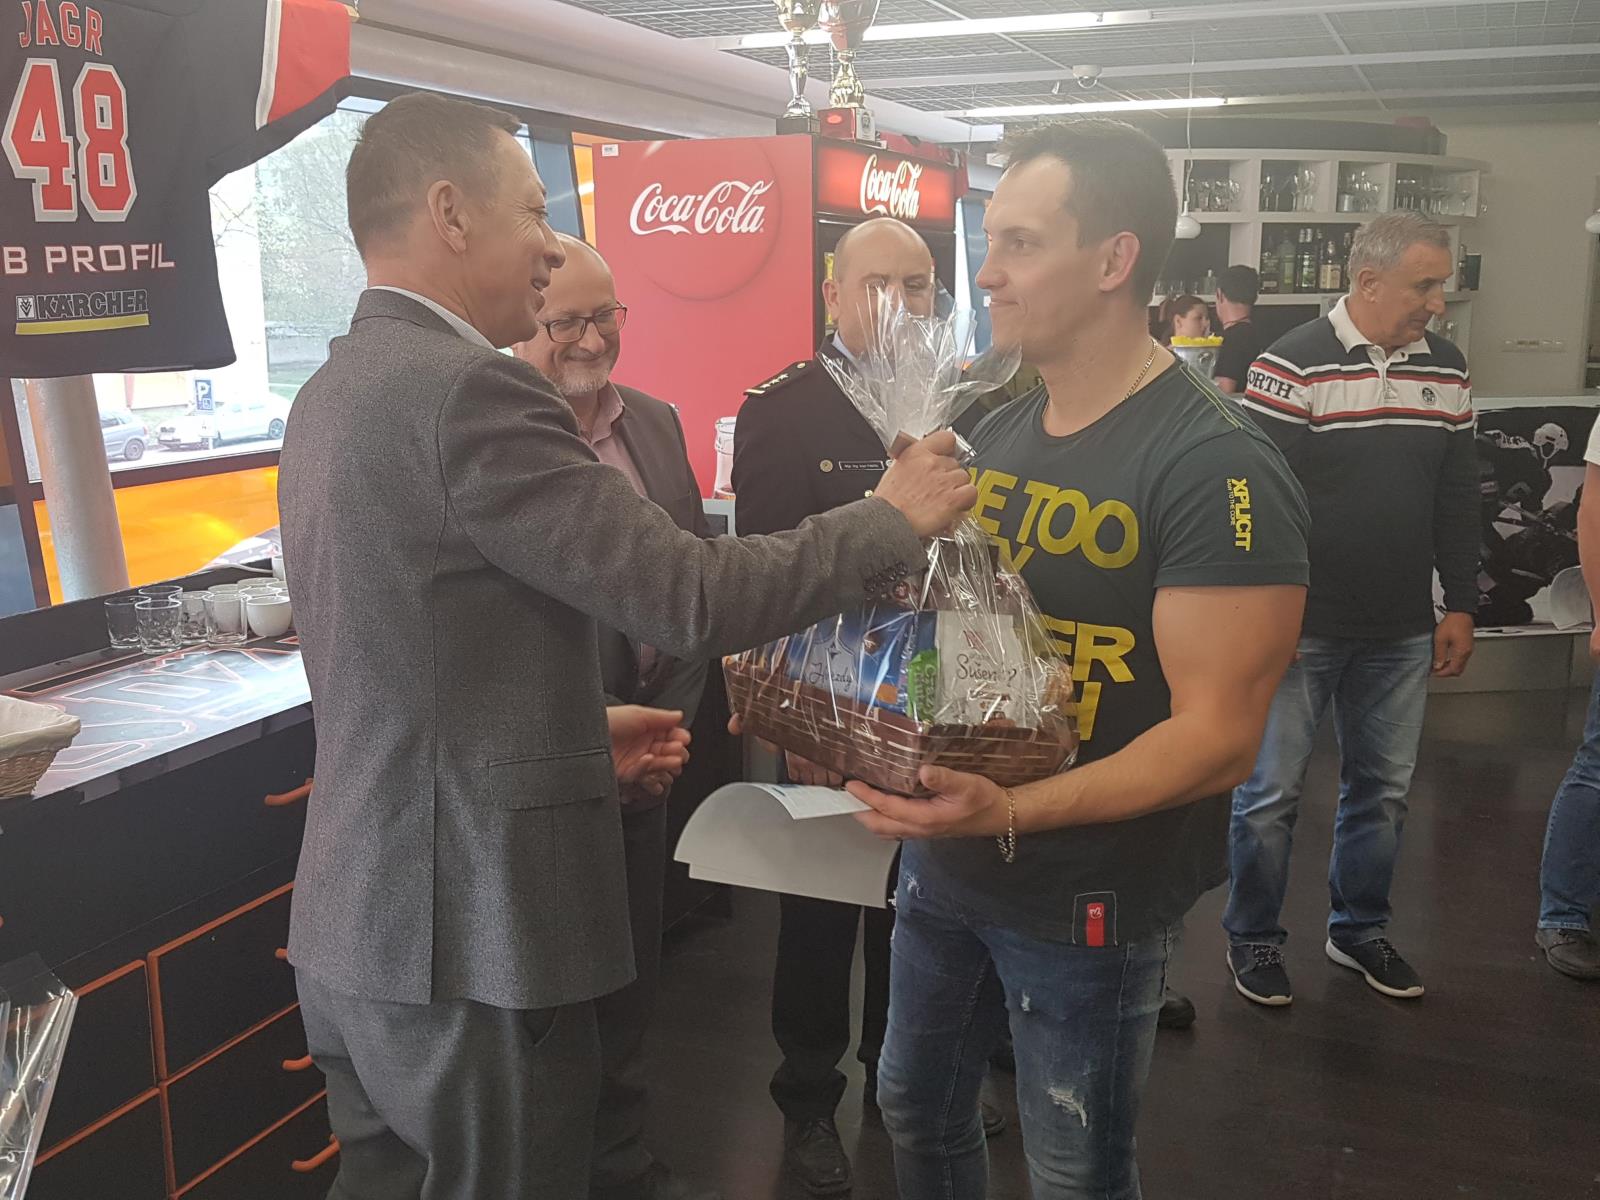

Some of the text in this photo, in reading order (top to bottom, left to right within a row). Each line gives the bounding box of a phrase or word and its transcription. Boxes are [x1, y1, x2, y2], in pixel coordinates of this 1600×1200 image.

[18, 0, 104, 56] JAGR
[1, 57, 138, 223] 48
[629, 180, 775, 236] Coca-Cola
[860, 153, 924, 219] Coca-Cola
[3, 242, 176, 275] B PROFIL
[36, 289, 149, 320] KÄRCHER
[1016, 479, 1140, 569] TOO
[1231, 477, 1252, 552] XPLICIT
